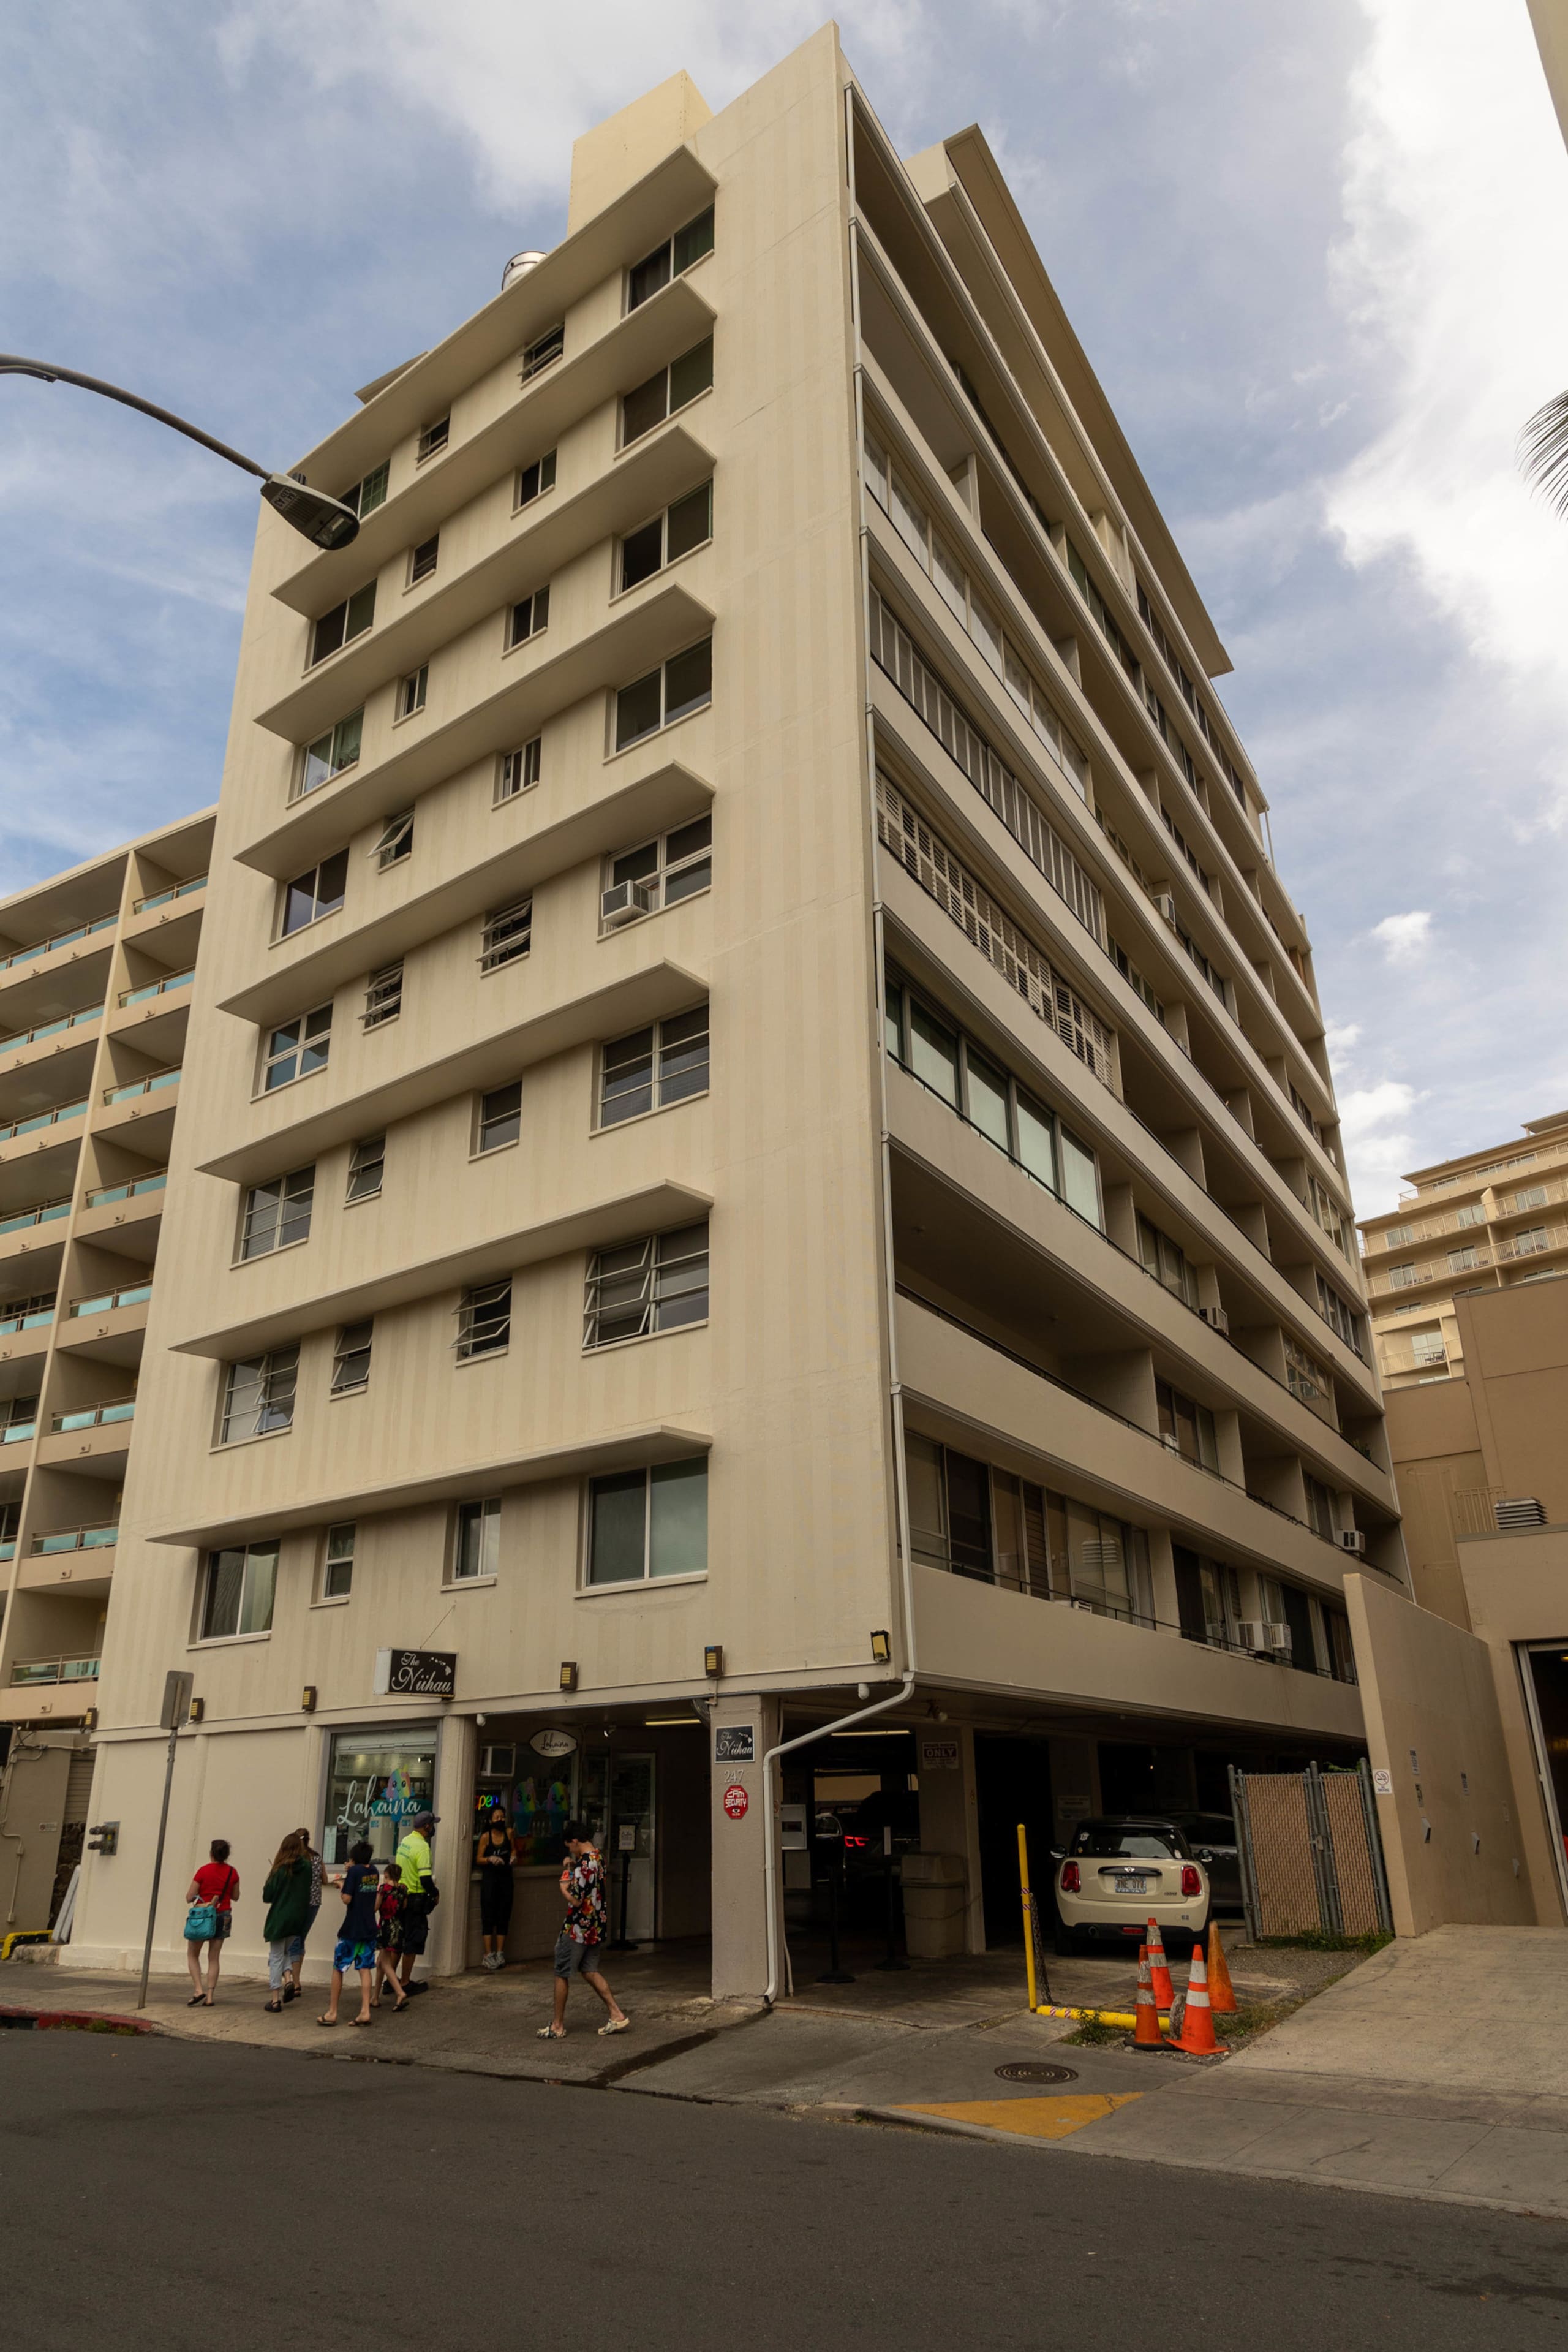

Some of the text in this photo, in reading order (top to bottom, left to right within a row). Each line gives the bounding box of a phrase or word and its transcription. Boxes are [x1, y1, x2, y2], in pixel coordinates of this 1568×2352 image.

[401, 1652, 420, 1666] The
[391, 1667, 451, 1692] Niihau
[540, 1732, 568, 1751] Lahaina
[717, 1741, 753, 1755] Niihau
[926, 1749, 954, 1757] ONLY
[724, 1769, 745, 1783] 247
[337, 1774, 421, 1826] Lahaina
[725, 1798, 747, 1808] SECURITY
